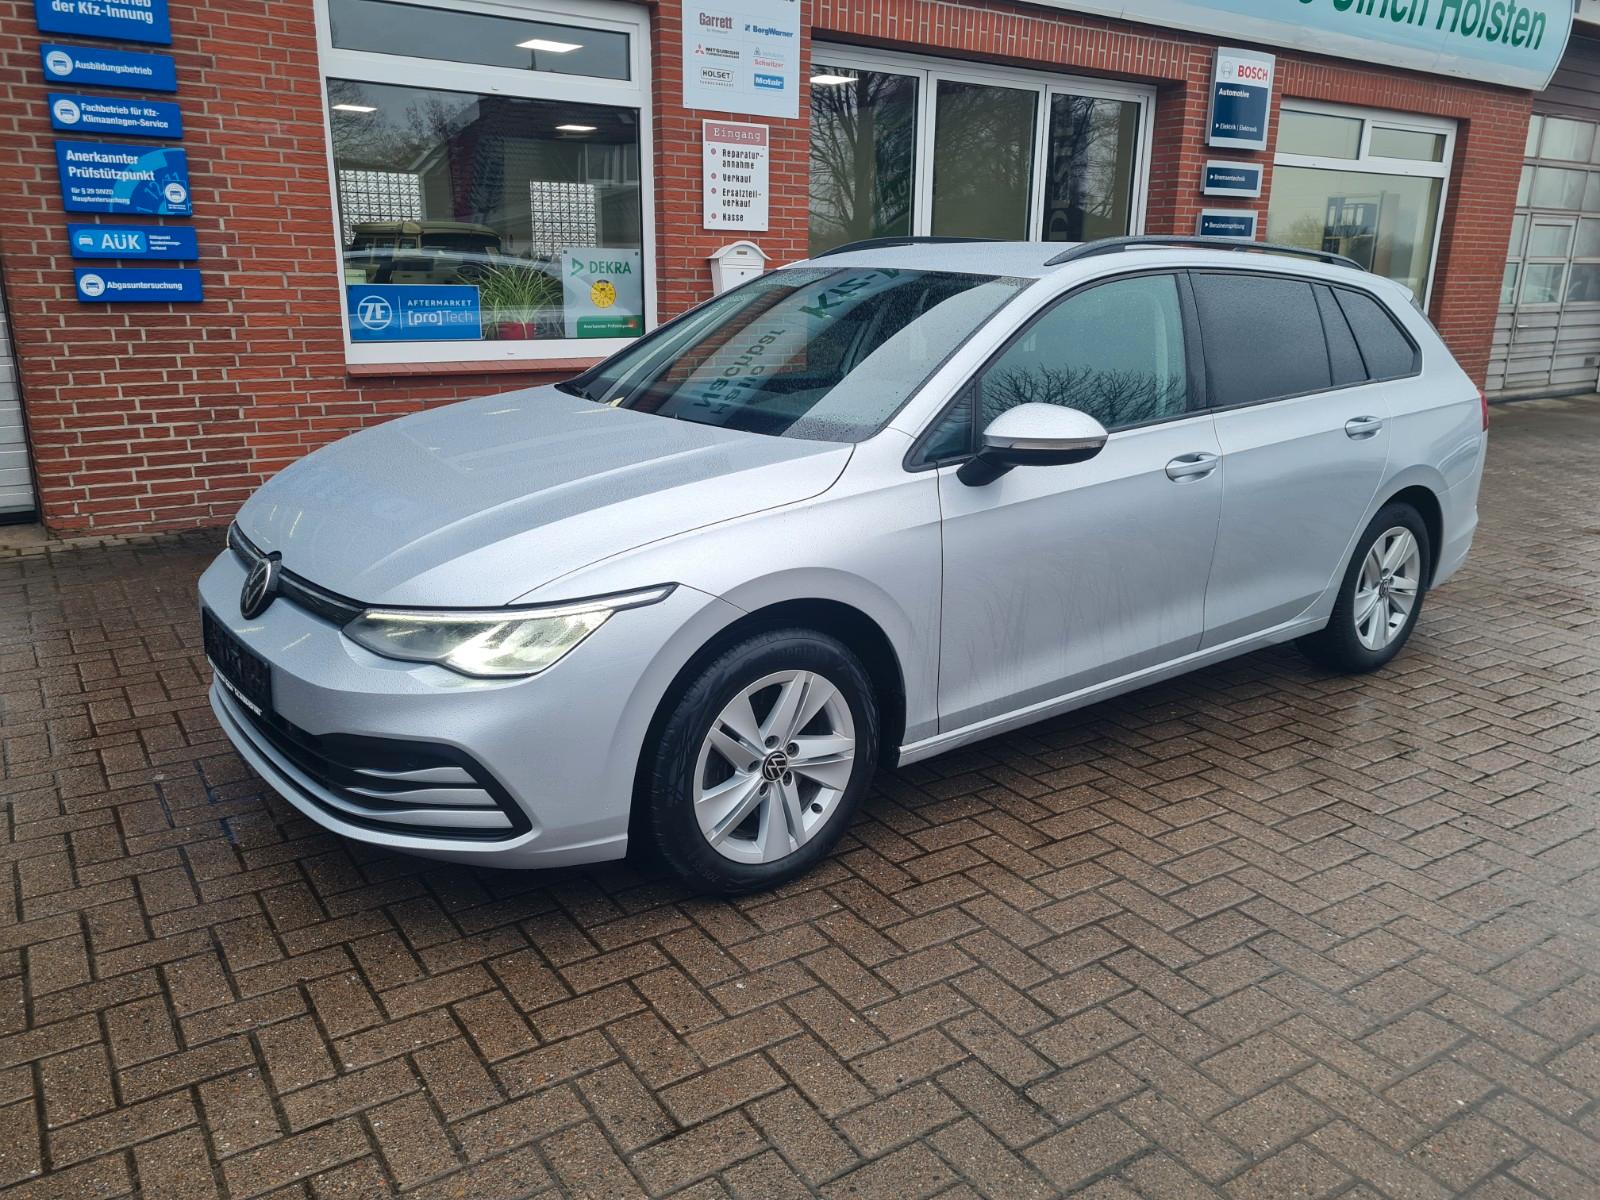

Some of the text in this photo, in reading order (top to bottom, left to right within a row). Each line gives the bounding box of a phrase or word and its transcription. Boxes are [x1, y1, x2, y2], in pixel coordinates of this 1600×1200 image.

[52, 0, 75, 13] der
[78, 1, 154, 25] Kfz-Innung
[699, 12, 733, 30] Garrett
[752, 25, 794, 38] BorgWarner
[75, 60, 153, 76] Ausbildungsbetrieb
[702, 69, 731, 79] HOLSET
[1237, 64, 1269, 81] BOSCH
[1218, 87, 1250, 99] Automotive
[81, 103, 160, 117] Fachbetrieb für Kfz-
[82, 114, 169, 129] Klimaanlagen-Service
[713, 127, 761, 142] Eingang
[66, 150, 139, 165] Anerkannter
[722, 148, 764, 160] Reparatur-
[722, 159, 755, 170] annahme
[68, 166, 155, 182] Prüfstützpunkt
[722, 173, 752, 184] Verkauf
[722, 187, 762, 199] Ersatzteil-
[722, 212, 744, 222] Kasse
[589, 260, 632, 275] DEKRA
[106, 281, 183, 291] Abgasuntersuchung
[407, 299, 473, 307] AFTERMARKET
